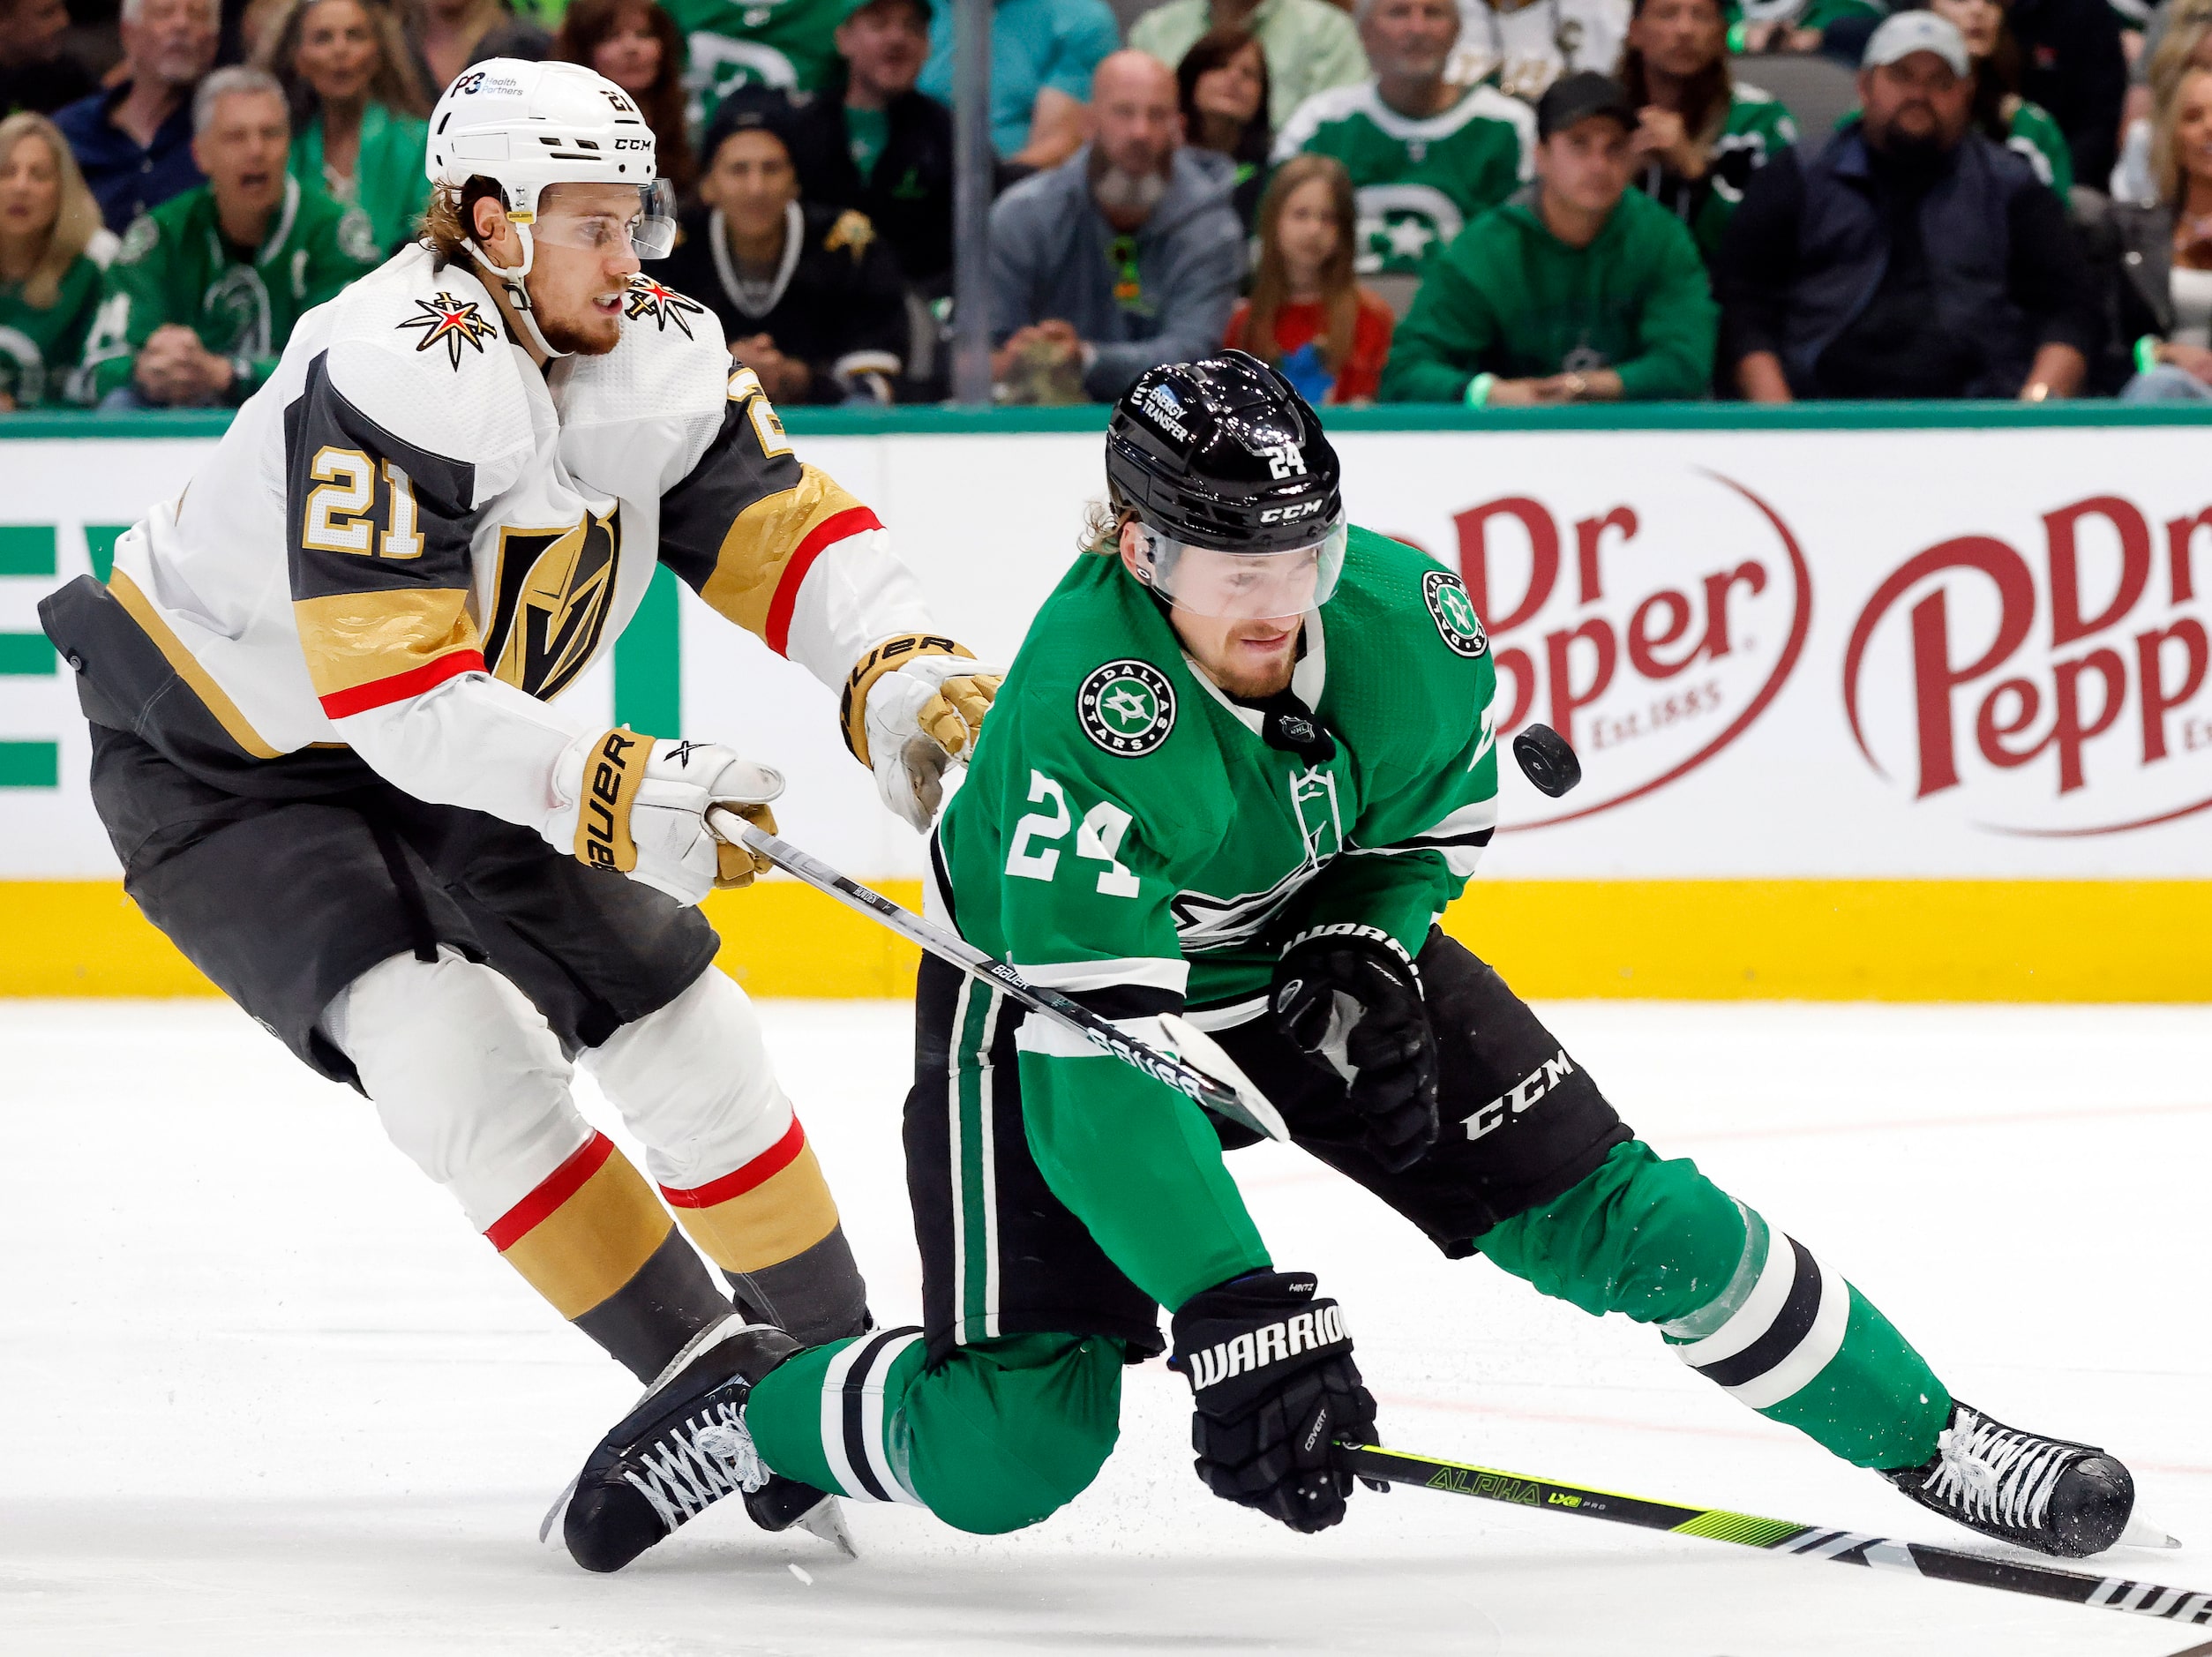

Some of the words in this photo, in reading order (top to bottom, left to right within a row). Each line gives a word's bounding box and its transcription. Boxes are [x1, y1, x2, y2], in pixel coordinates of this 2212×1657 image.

[450, 72, 485, 98] P3
[481, 85, 523, 96] Partners
[484, 78, 517, 86] Health
[614, 139, 651, 151] CCM
[1143, 401, 1190, 443] TRANSFER
[1149, 389, 1188, 421] ENERGY
[1263, 441, 1308, 480] 24
[302, 445, 424, 559] 21
[1259, 499, 1323, 523] CCM
[1453, 496, 1637, 639] Dr
[1101, 665, 1170, 730] DALLAS
[1084, 694, 1143, 750] STARS
[1004, 766, 1141, 898] 24
[852, 886, 879, 904] HOWDEN
[1459, 1049, 1574, 1141] CCM
[1288, 1282, 1315, 1293] HINTZ
[1304, 1408, 1327, 1452] COVERT
[1425, 1466, 1541, 1507] ALPHA
[1583, 1501, 1607, 1511] PRO
